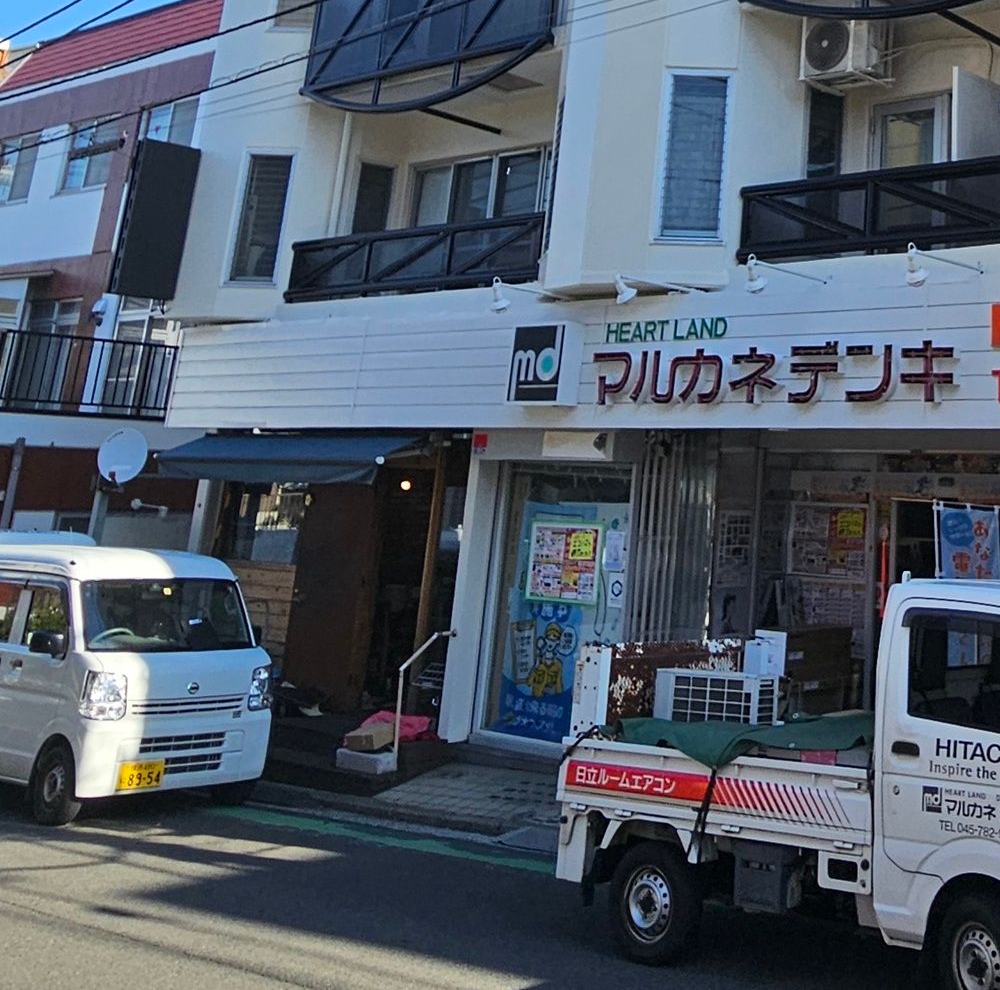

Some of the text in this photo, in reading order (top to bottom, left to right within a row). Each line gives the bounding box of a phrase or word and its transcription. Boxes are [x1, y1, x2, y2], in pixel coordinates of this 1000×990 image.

[606, 316, 729, 344] HEART LAND
[593, 339, 957, 406] マルカネデンキ
[575, 765, 676, 794] 日立ルームエアコン
[929, 760, 973, 778] Inspire
[976, 765, 997, 780] the
[944, 788, 966, 797] HEART
[967, 791, 987, 800] LAND
[939, 819, 956, 833] TEL
